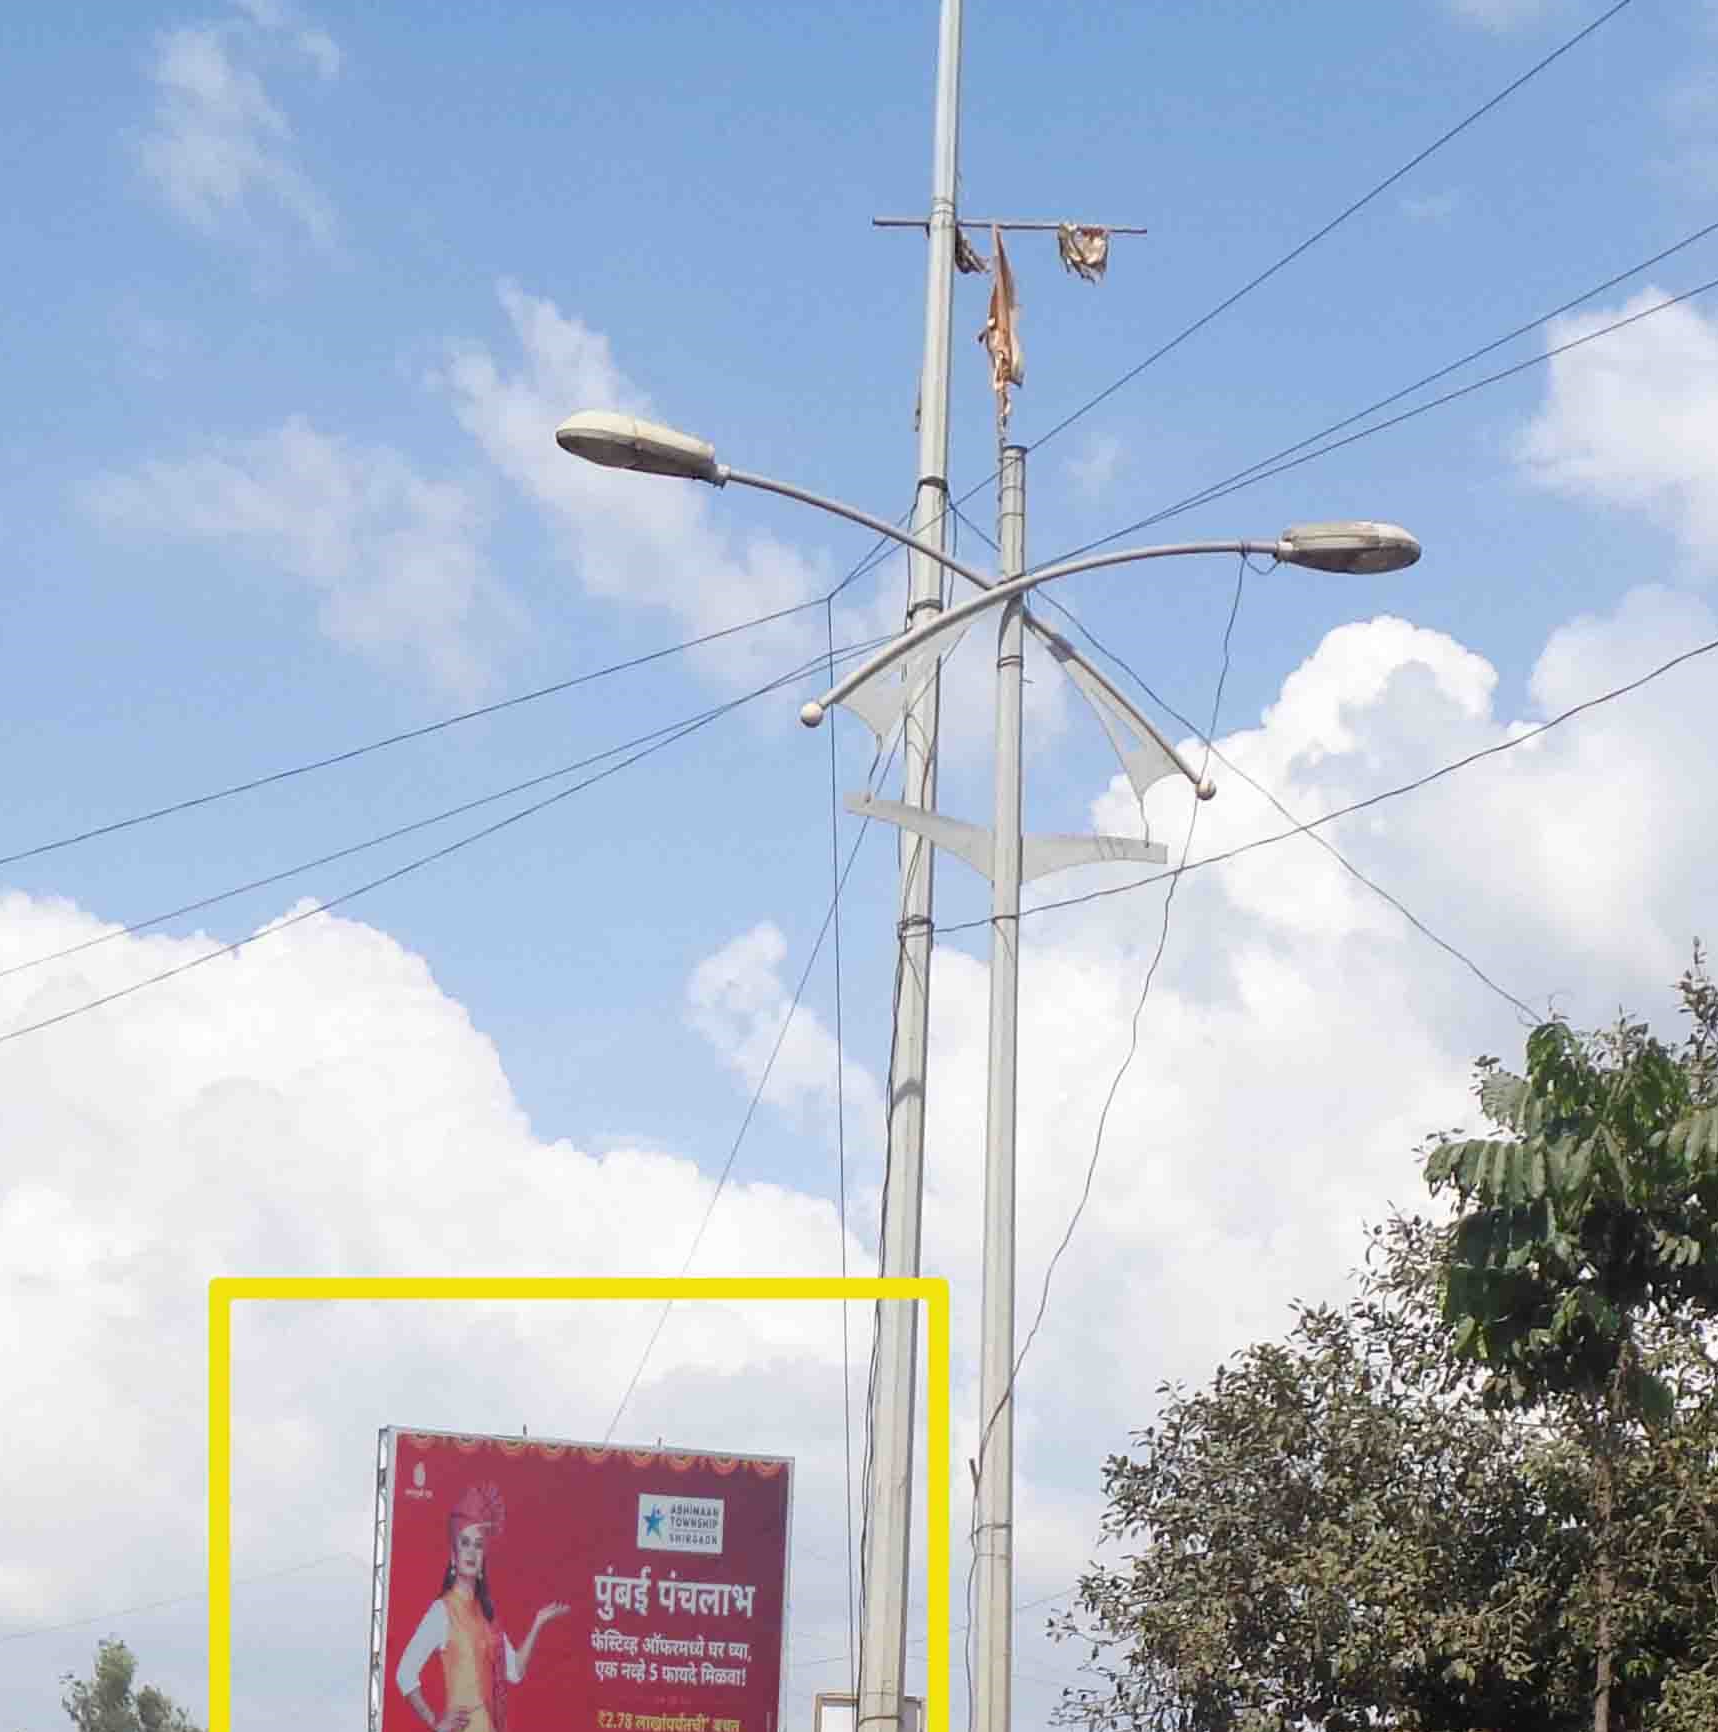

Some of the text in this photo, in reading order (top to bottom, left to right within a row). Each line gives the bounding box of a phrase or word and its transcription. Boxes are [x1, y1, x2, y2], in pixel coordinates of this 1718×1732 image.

[670, 1515, 718, 1528] TOWNSHIP
[658, 1570, 755, 1617] पंचलाभ
[595, 1660, 618, 1681] एक
[649, 1663, 658, 1681] 5
